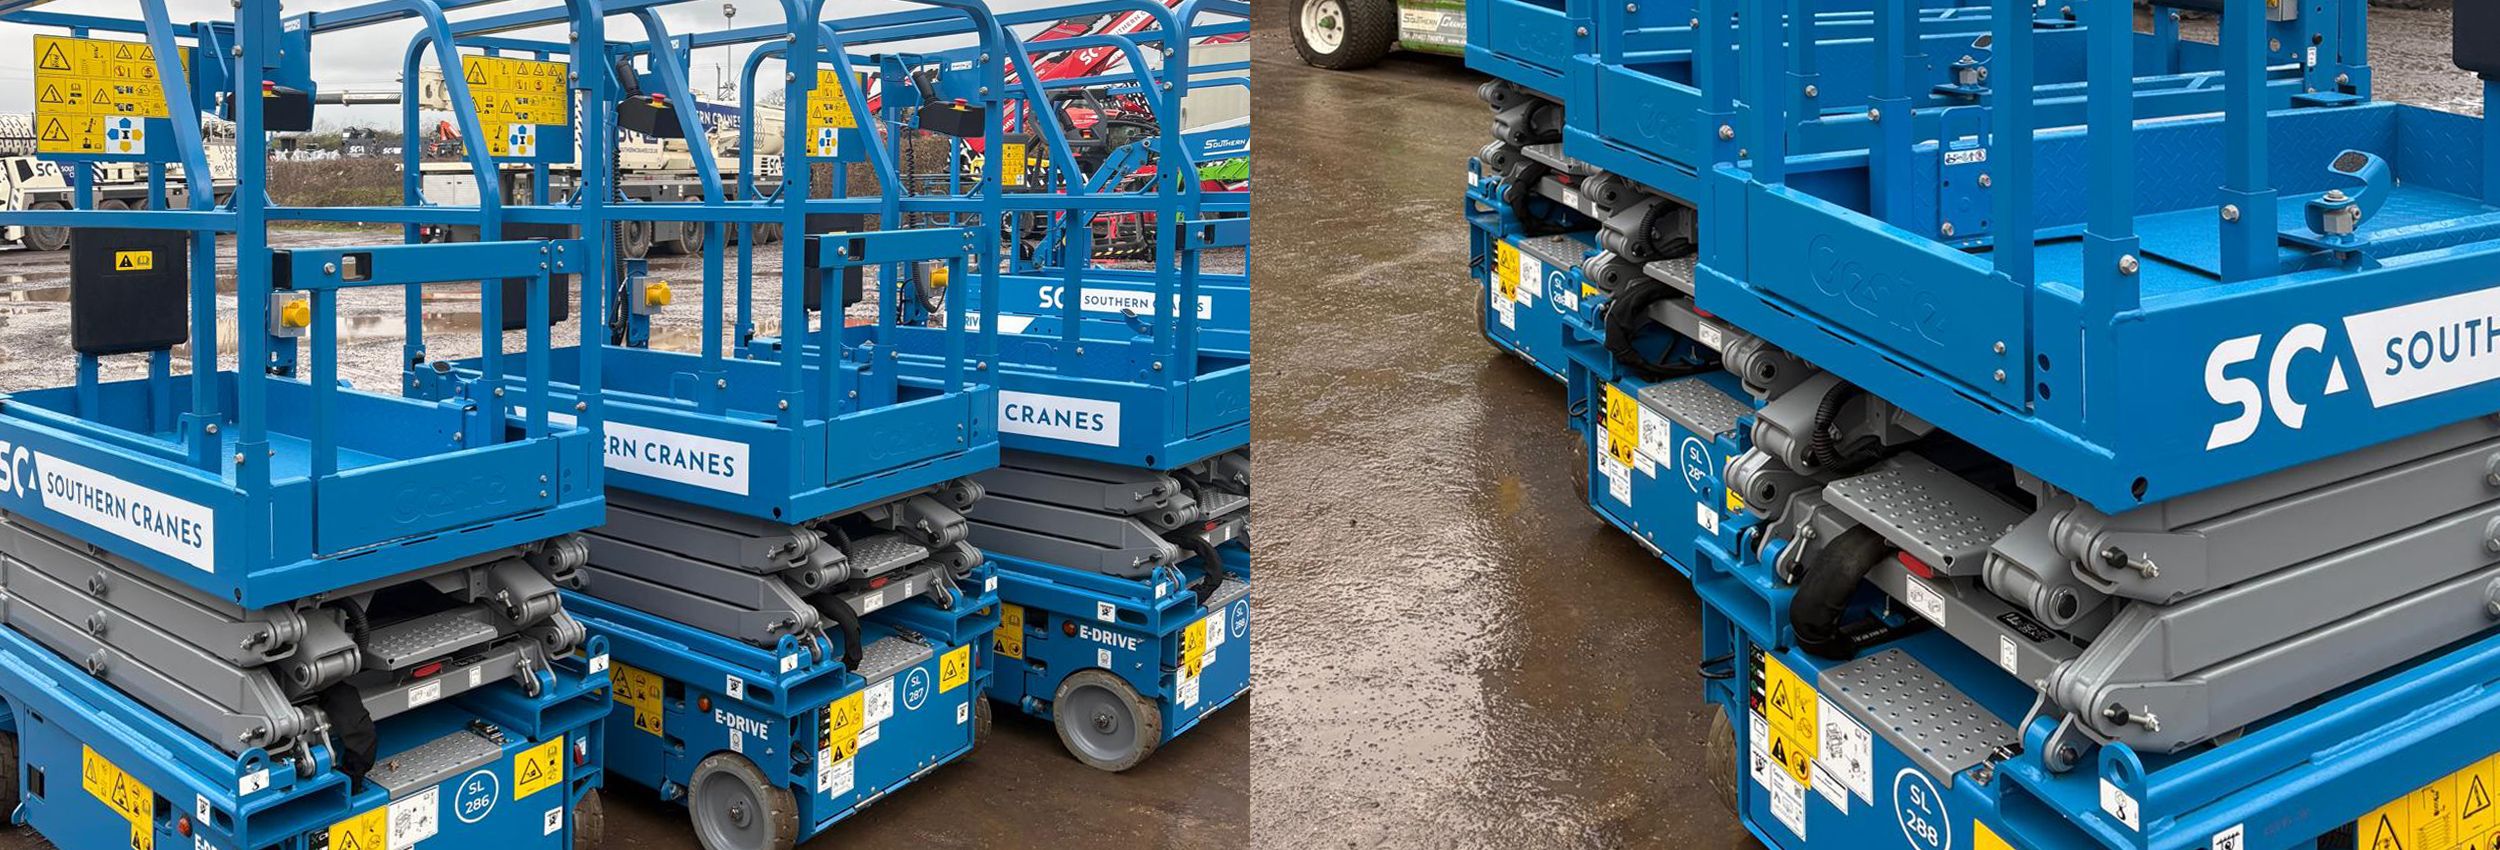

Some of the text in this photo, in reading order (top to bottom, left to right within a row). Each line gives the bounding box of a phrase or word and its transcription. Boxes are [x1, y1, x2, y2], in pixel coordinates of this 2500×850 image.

[1084, 295, 1149, 309] SOUTHERN
[2204, 323, 2349, 451] SCA
[1005, 403, 1104, 432] CRANES
[644, 443, 735, 478] CRANES
[1689, 447, 1703, 465] SL
[47, 471, 126, 520] SOUTHERN
[132, 502, 202, 549] CRANES
[1080, 624, 1137, 652] E-DRIVE
[911, 675, 921, 687] SL
[908, 688, 924, 703] 287
[715, 708, 768, 741] E-DRIVE
[468, 780, 485, 795] SL
[1910, 784, 1932, 815] SL
[465, 794, 489, 815] 286
[1906, 808, 1939, 847] 288
